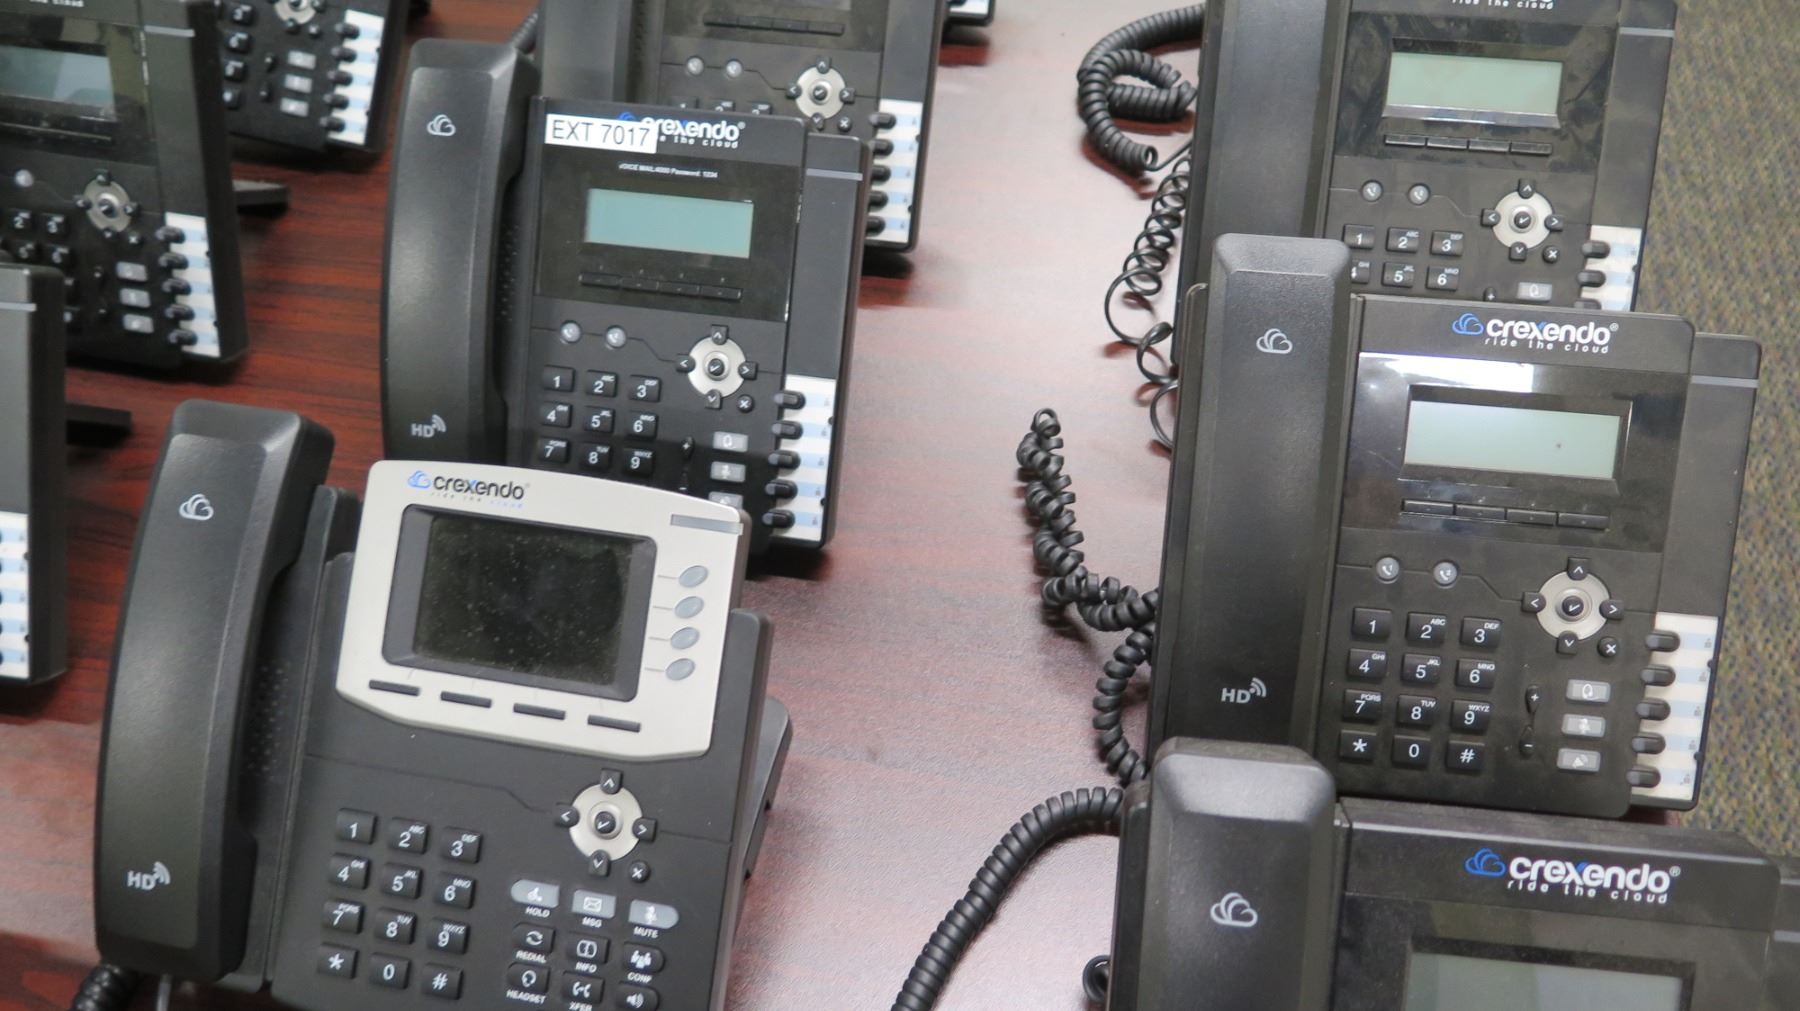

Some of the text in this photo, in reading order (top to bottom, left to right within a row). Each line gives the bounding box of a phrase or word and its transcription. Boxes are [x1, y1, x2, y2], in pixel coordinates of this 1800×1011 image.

[1516, 0, 1554, 10] cloud
[552, 119, 650, 147] EXT 7017
[641, 117, 740, 142] rexendo
[1356, 233, 1362, 245] 1
[1398, 237, 1408, 248] 2
[1442, 240, 1452, 252] 3
[1394, 271, 1404, 283] 5
[1437, 274, 1447, 285] 6
[1486, 318, 1611, 346] crexendo
[1484, 337, 1608, 354] ride the cloud
[554, 376, 560, 388] 1
[594, 381, 604, 393] 2
[637, 385, 646, 398] 3
[547, 410, 556, 422] 4
[591, 415, 600, 427] 5
[633, 420, 643, 432] 6
[545, 446, 554, 457] 7
[589, 452, 598, 464] 8
[631, 457, 640, 469] 9
[433, 476, 524, 500] crexendo
[1369, 620, 1376, 634] 1
[1420, 625, 1432, 639] 2
[1474, 629, 1485, 643] 3
[1359, 659, 1370, 673] 4
[1416, 665, 1427, 679] 5
[1470, 669, 1480, 684] 6
[1221, 688, 1251, 703] HD
[1355, 700, 1366, 714] 7
[1411, 706, 1422, 720] 8
[1464, 711, 1475, 725] 9
[1409, 744, 1420, 758] 0
[1460, 749, 1475, 763] #
[350, 823, 358, 838] 1
[399, 832, 411, 848] 2
[451, 841, 463, 856] 3
[127, 870, 157, 890] HD
[338, 866, 349, 882] 4
[1509, 856, 1671, 893] crexendo
[392, 876, 403, 891] 5
[444, 886, 456, 901] 6
[1507, 879, 1668, 904] ride the cloud
[333, 910, 345, 926] 7
[525, 906, 659, 938] HOLD MSG MUTE
[386, 922, 398, 938] 8
[438, 931, 450, 947] 9
[383, 964, 395, 980] 0
[516, 951, 653, 983] REDIAL INFO CONF
[432, 973, 448, 990] #
[506, 989, 546, 1004] HEADSET
